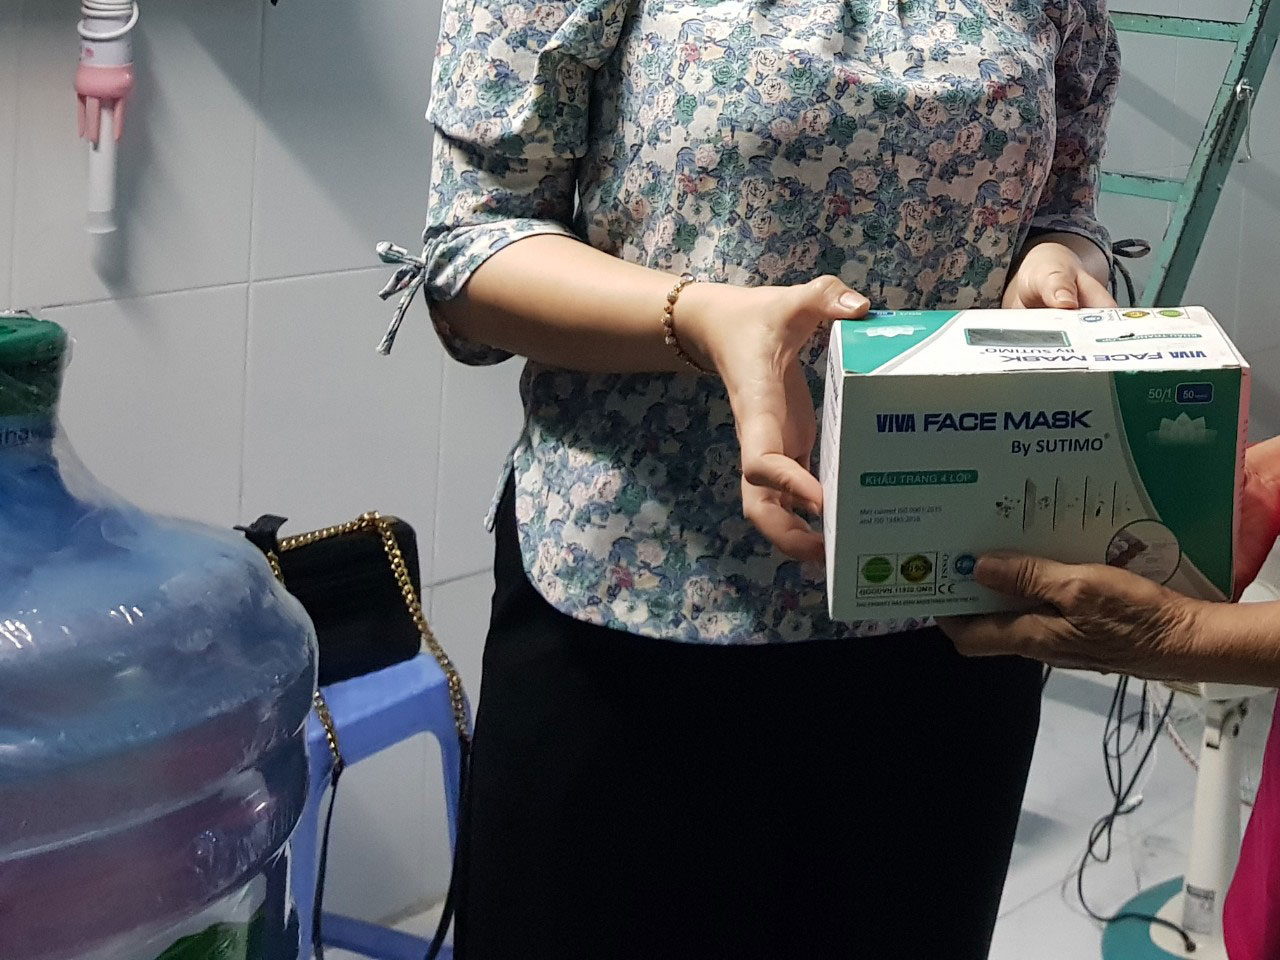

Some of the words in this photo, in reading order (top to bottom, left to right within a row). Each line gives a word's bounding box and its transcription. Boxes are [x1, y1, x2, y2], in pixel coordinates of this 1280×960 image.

[1000, 354, 1088, 363] MASK
[1093, 351, 1163, 361] FACE
[1168, 350, 1207, 359] VIVA
[1148, 387, 1172, 401] 50/1
[876, 413, 916, 433] VIVA
[923, 412, 998, 433] FACE
[1003, 410, 1093, 431] MASK
[1011, 440, 1031, 457] By
[1035, 437, 1104, 453] SUTIMO
[900, 474, 938, 484] TRANG
